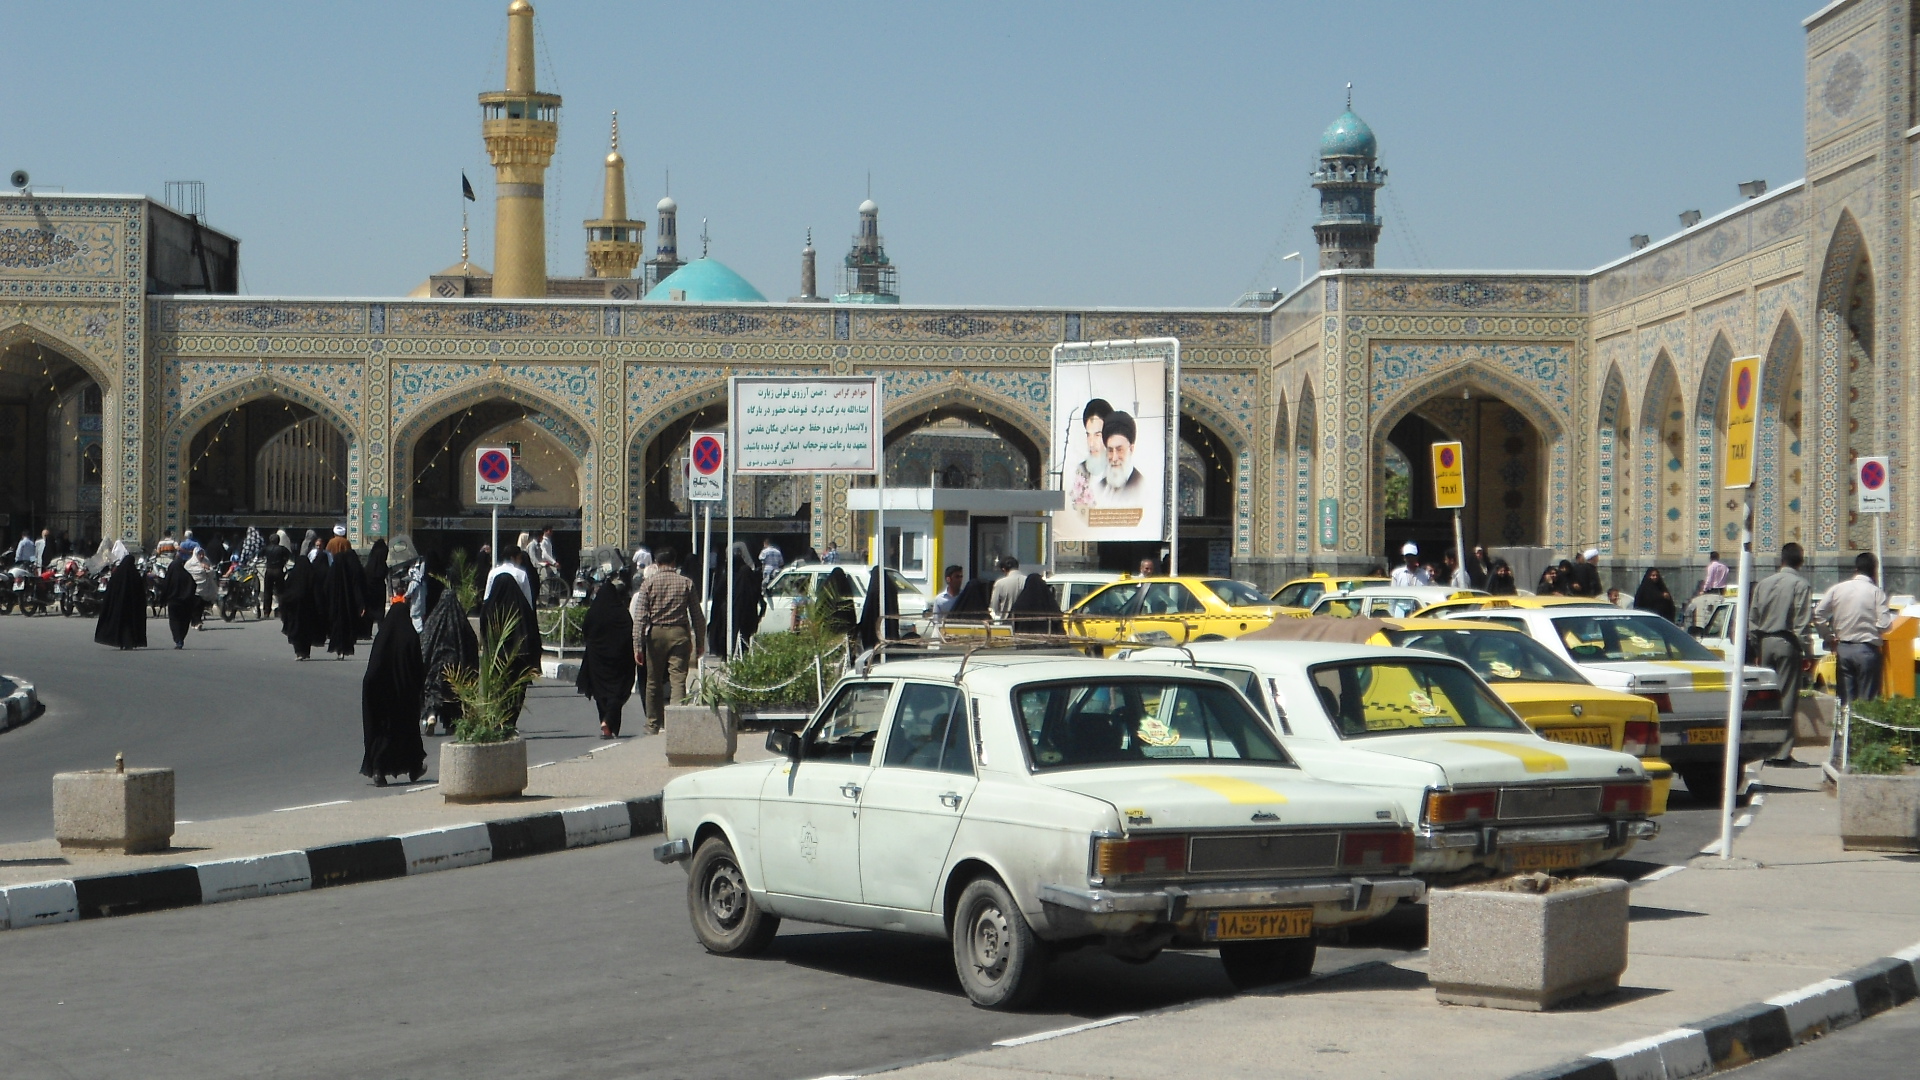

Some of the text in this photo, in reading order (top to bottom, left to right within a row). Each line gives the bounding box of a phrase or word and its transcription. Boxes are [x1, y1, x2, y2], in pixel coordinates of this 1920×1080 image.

[757, 388, 774, 399] زیارت
[775, 387, 791, 399] قبولی
[791, 386, 809, 399] آرزوی
[810, 390, 824, 399] ضمن
[833, 388, 850, 398] گرامی
[851, 390, 868, 399] خواهر
[746, 405, 763, 417] بارگاه
[763, 407, 771, 416] در
[771, 408, 787, 417] حضور
[788, 405, 808, 417] فیوضات
[811, 405, 824, 417] درک
[825, 405, 840, 417] برکت
[747, 425, 765, 435] مقدس
[765, 423, 779, 435] مکان
[779, 424, 789, 435] این
[789, 424, 806, 435] حرمت
[808, 423, 821, 432] حفظ
[826, 424, 844, 434] رضوی
[760, 441, 780, 453] گردیده
[781, 441, 800, 453] اسلامی
[829, 440, 845, 452] رعایت
[852, 441, 867, 449] متعهد
[746, 459, 763, 468] رضوی
[778, 458, 795, 467] آستان
